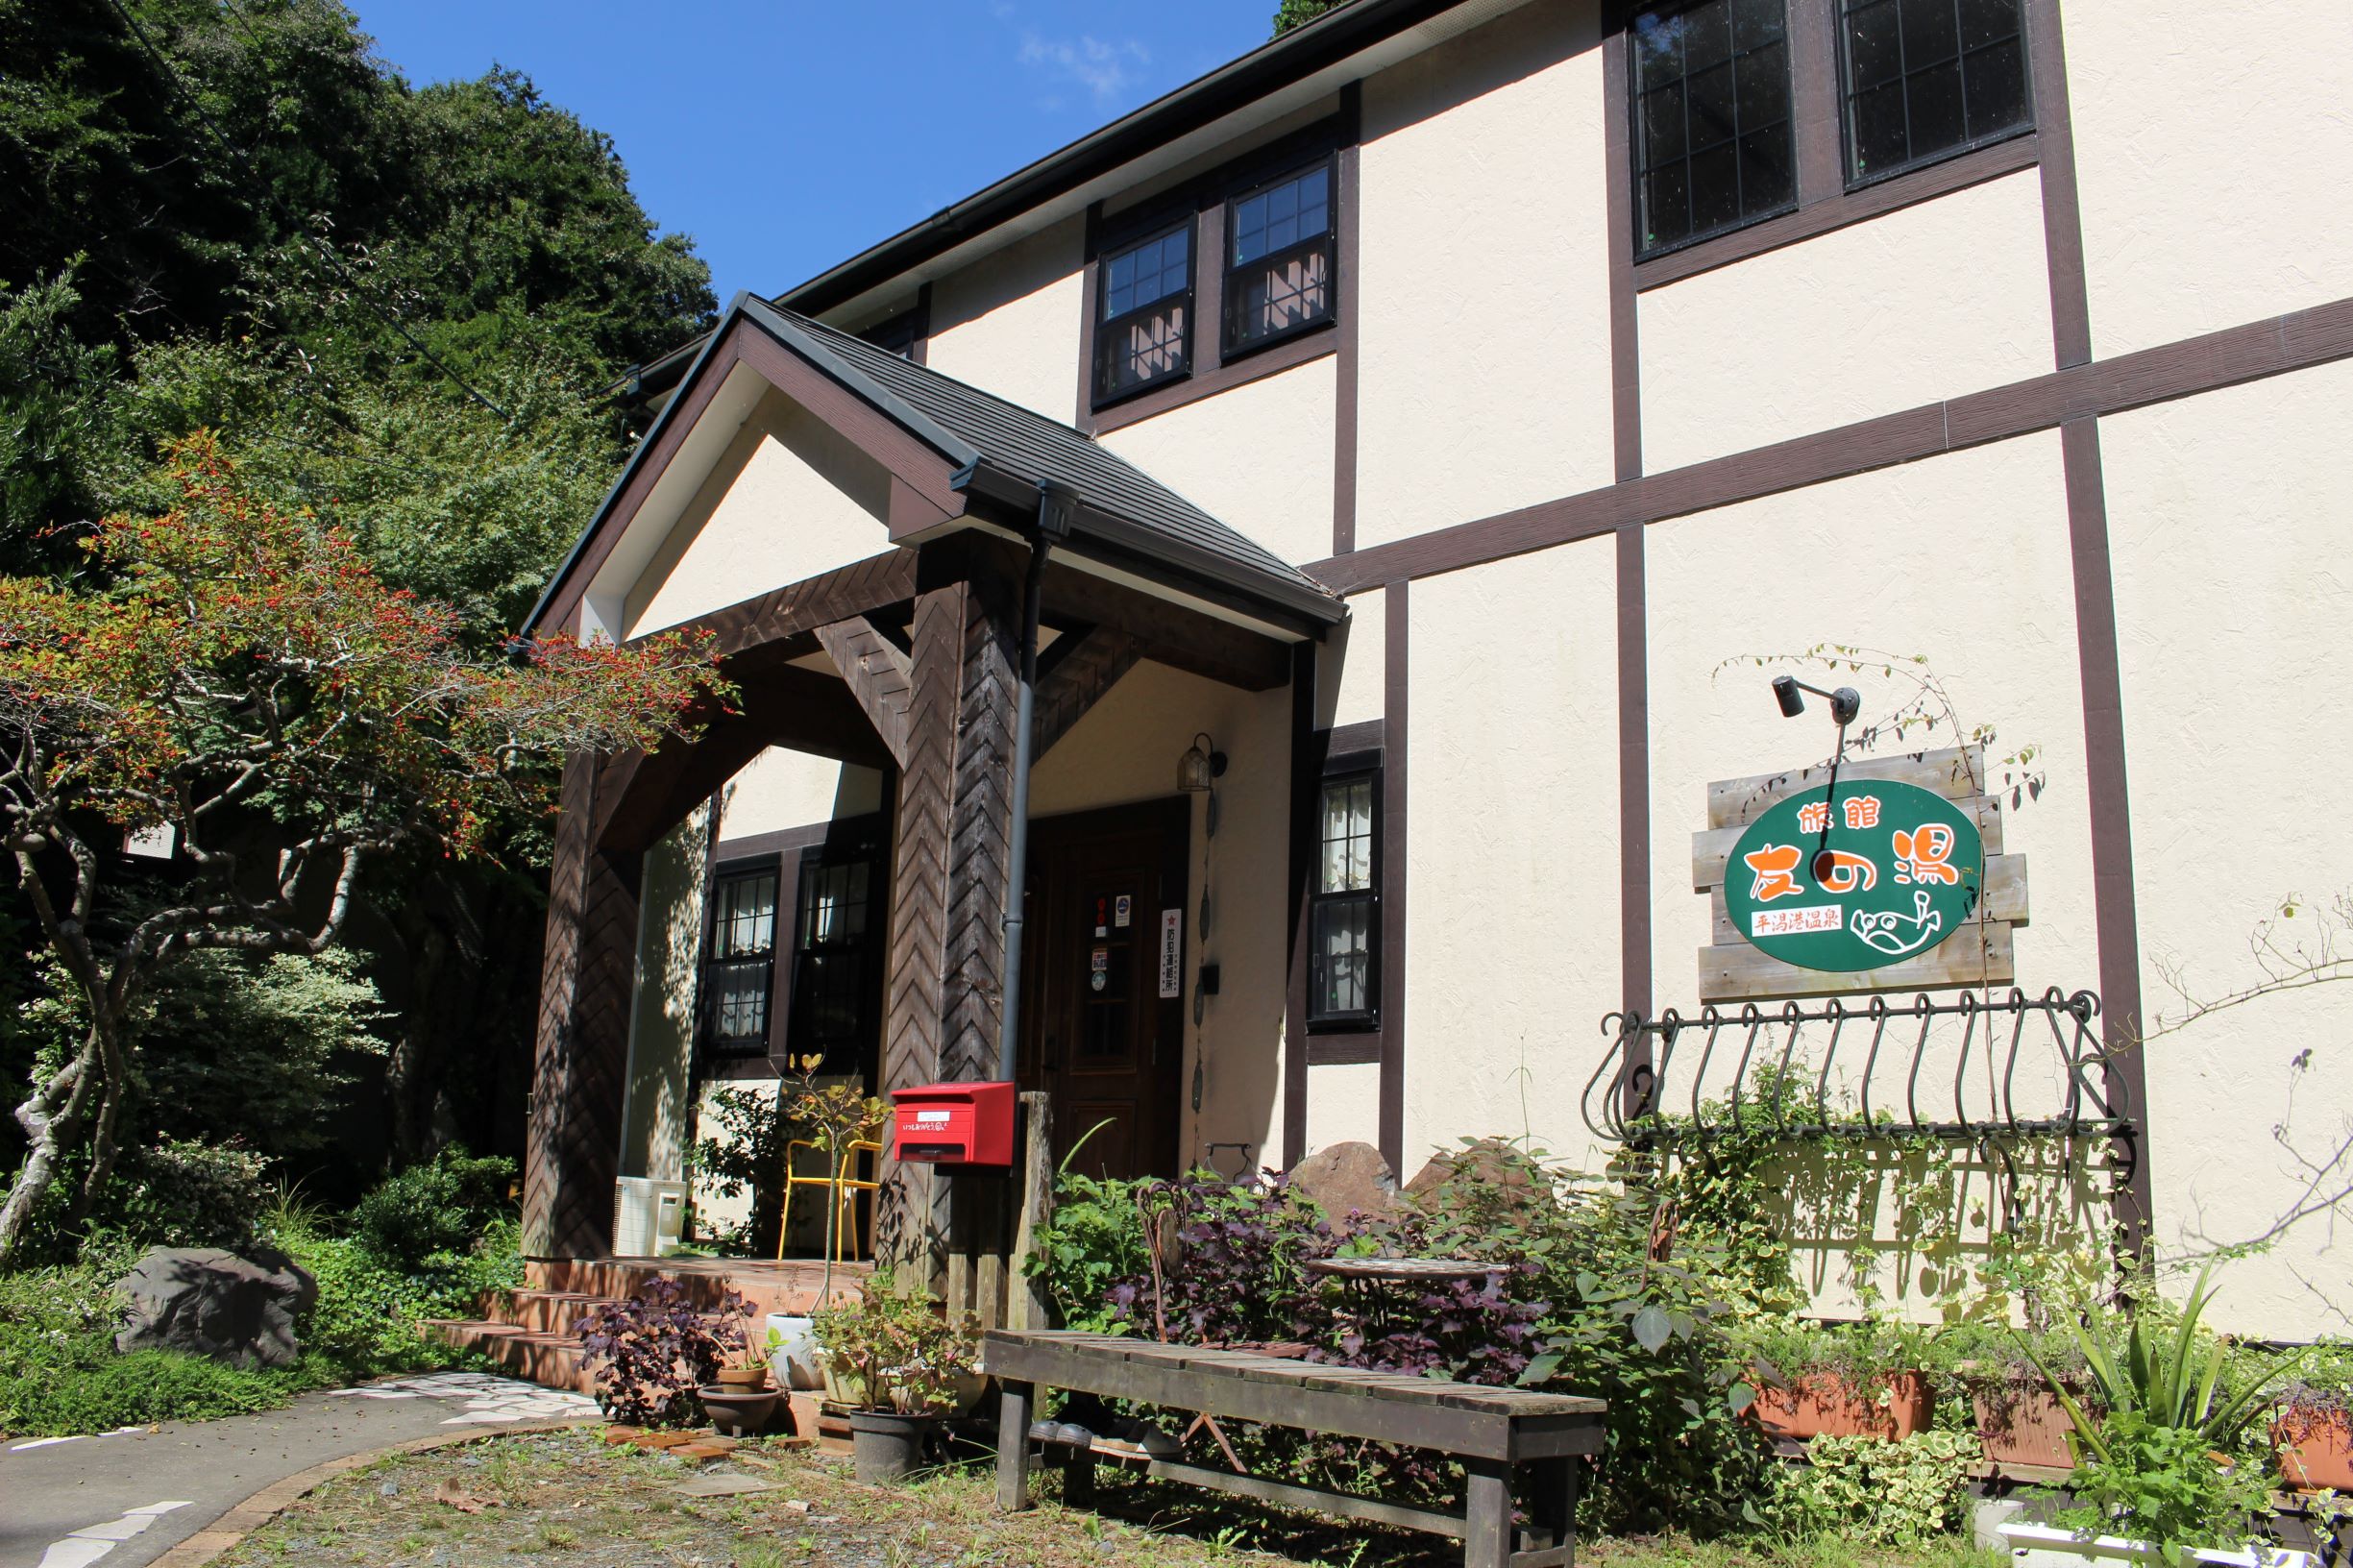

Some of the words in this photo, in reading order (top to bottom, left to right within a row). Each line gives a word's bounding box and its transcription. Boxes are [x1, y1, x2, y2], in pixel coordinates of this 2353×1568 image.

[1797, 796, 1881, 834] 旅館
[1744, 823, 1959, 902] 友の湯
[1753, 907, 1840, 934] 平潟港温泉
